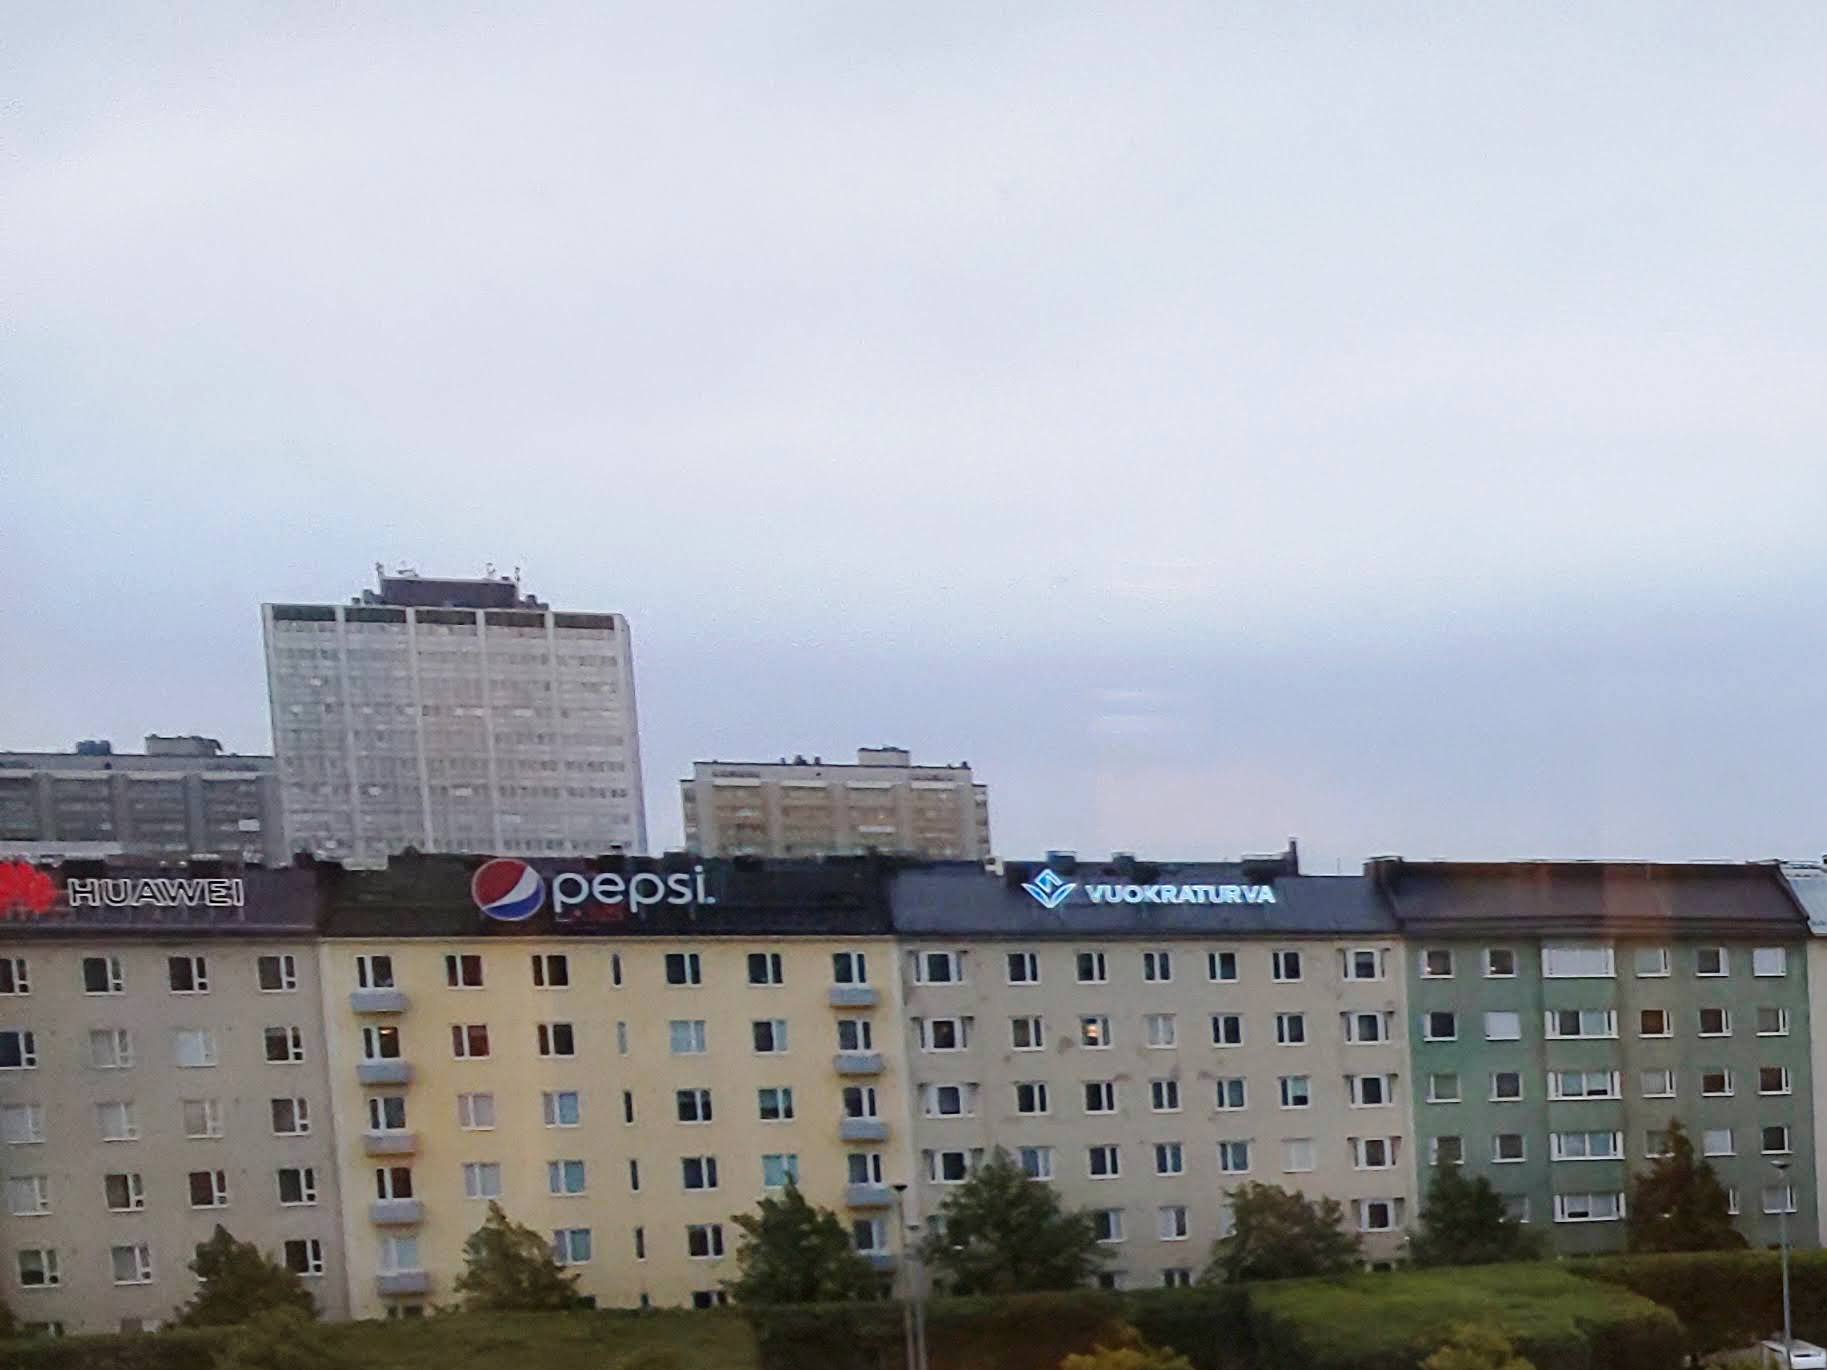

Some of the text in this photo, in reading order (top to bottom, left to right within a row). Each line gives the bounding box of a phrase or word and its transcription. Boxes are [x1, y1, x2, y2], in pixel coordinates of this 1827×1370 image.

[67, 878, 245, 907] HUAWEI
[551, 865, 706, 914] pepsi
[1084, 884, 1277, 905] VUOKRATURVA
